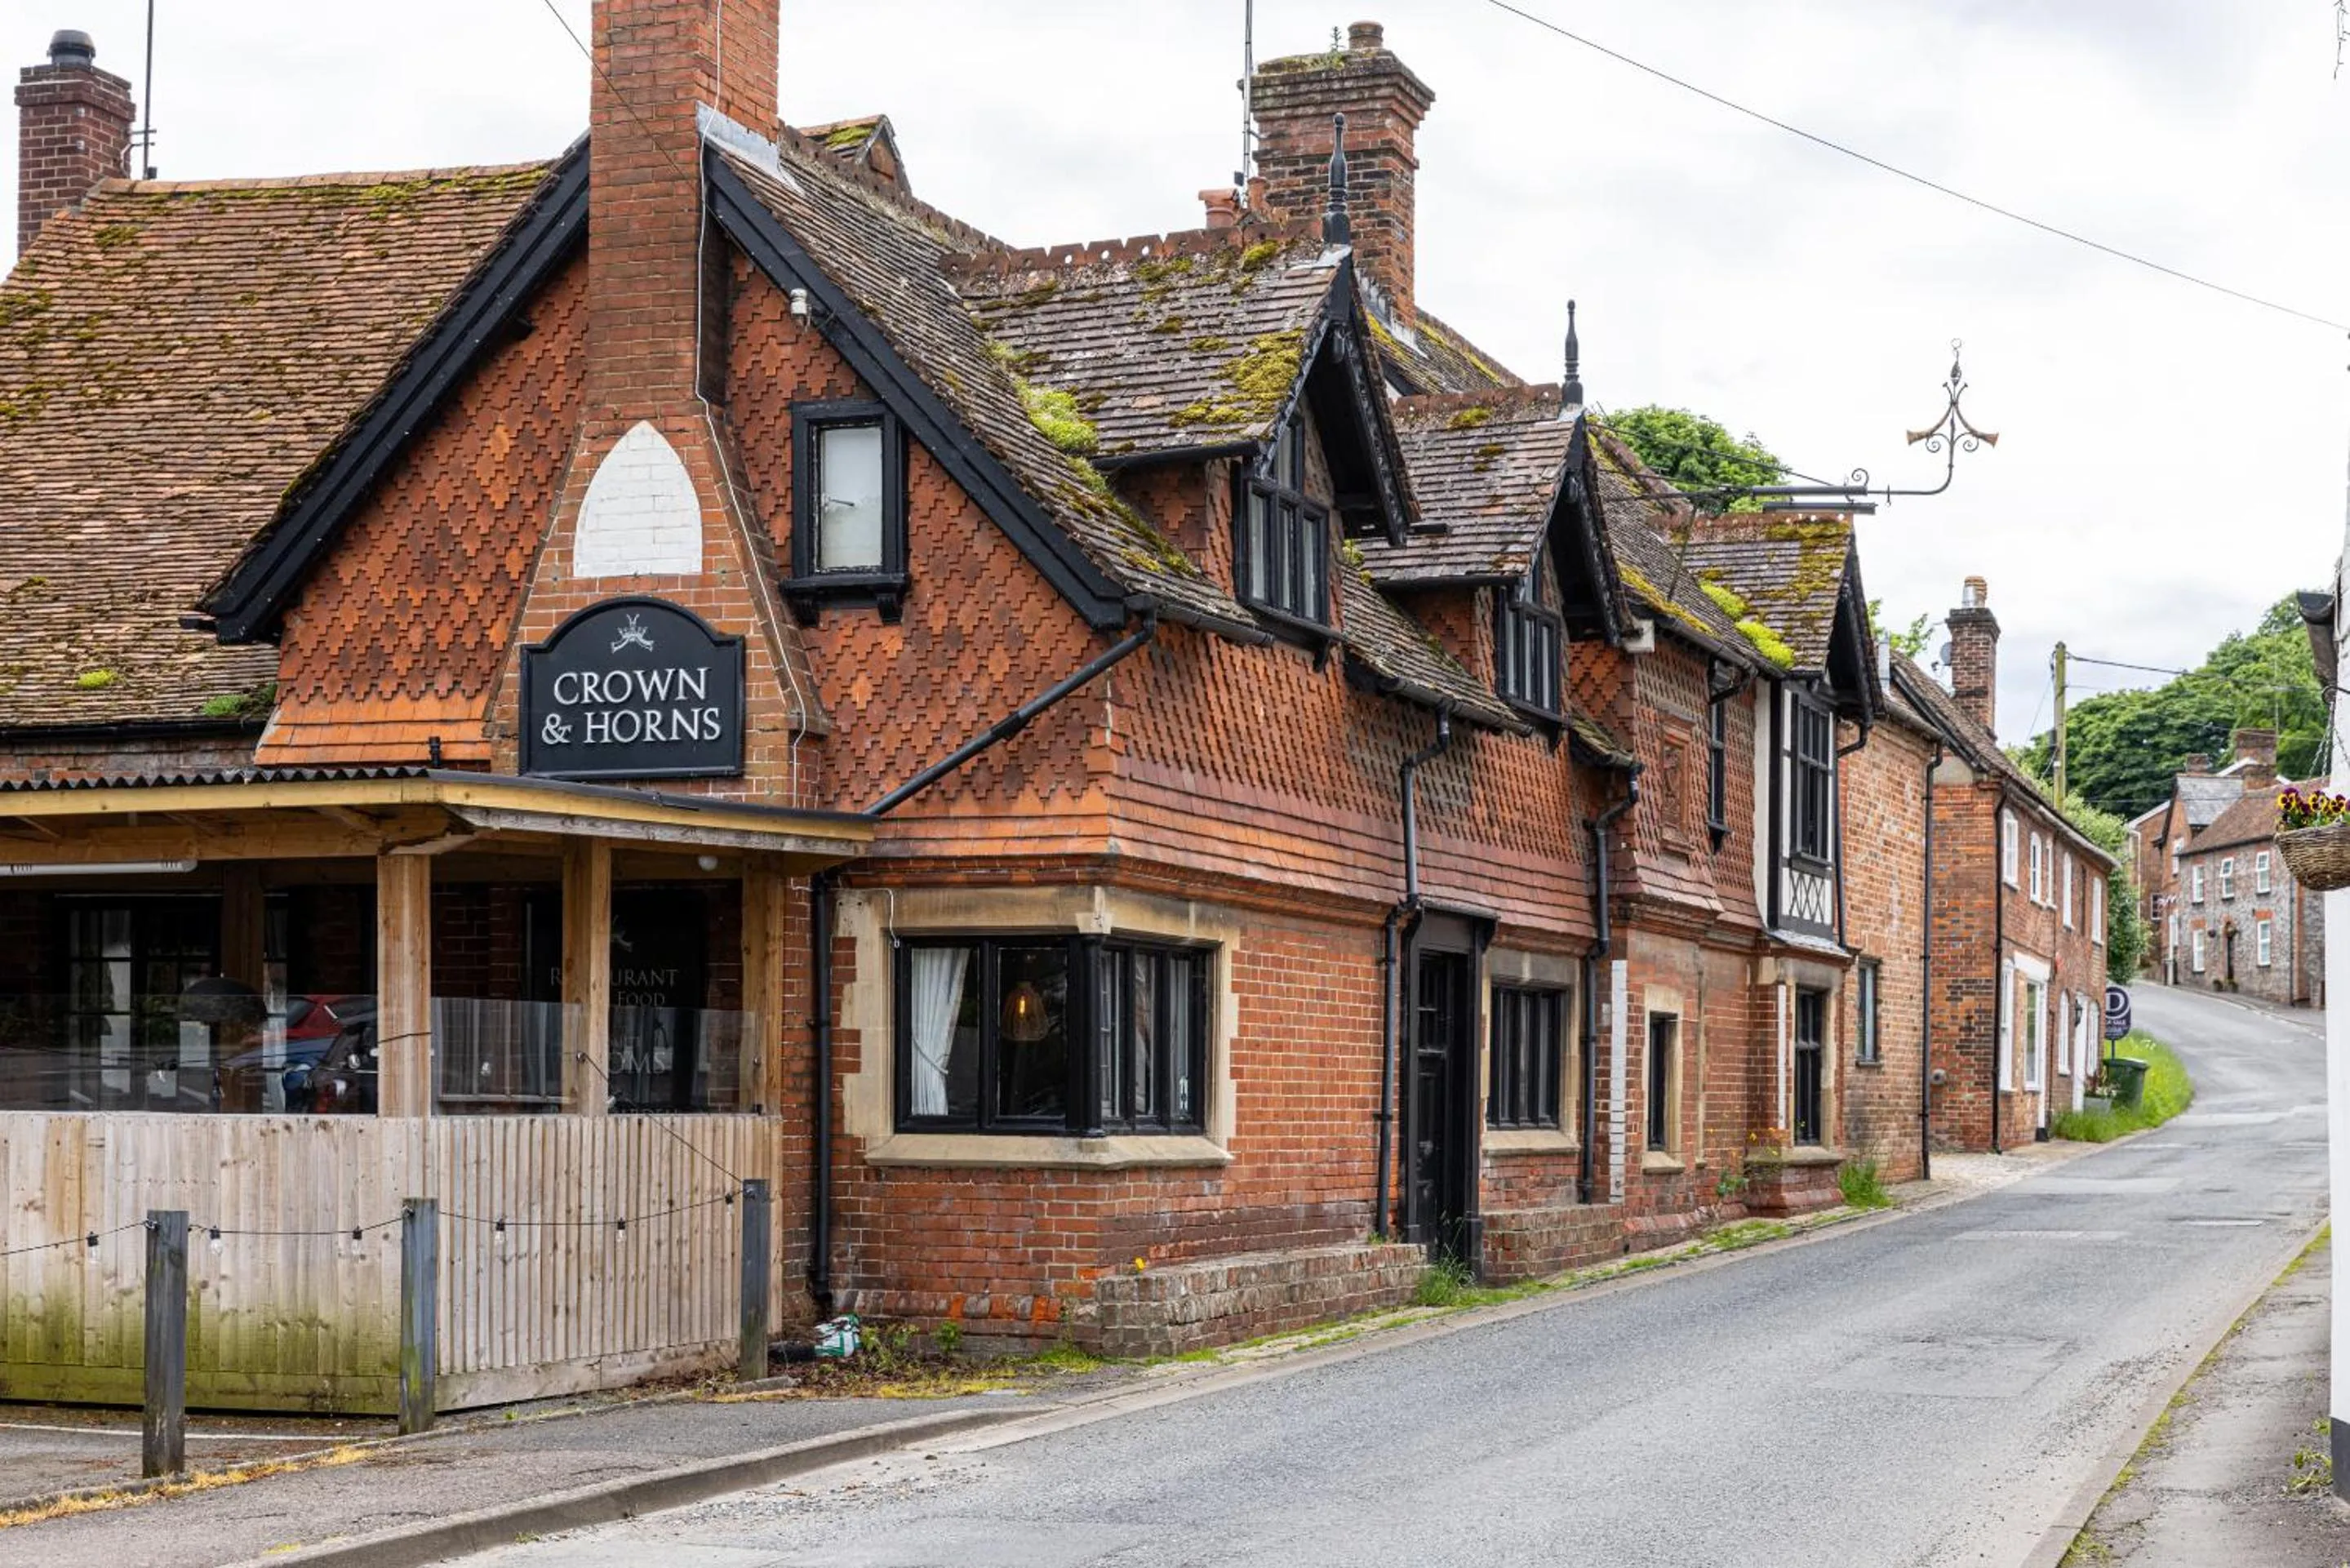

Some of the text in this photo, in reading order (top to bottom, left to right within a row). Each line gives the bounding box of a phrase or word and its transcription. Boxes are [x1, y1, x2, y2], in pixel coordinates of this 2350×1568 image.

[553, 667, 712, 705] CROWN
[541, 707, 722, 745] & HORNS
[549, 966, 679, 987] RURANT
[616, 990, 665, 1006] FOOD
